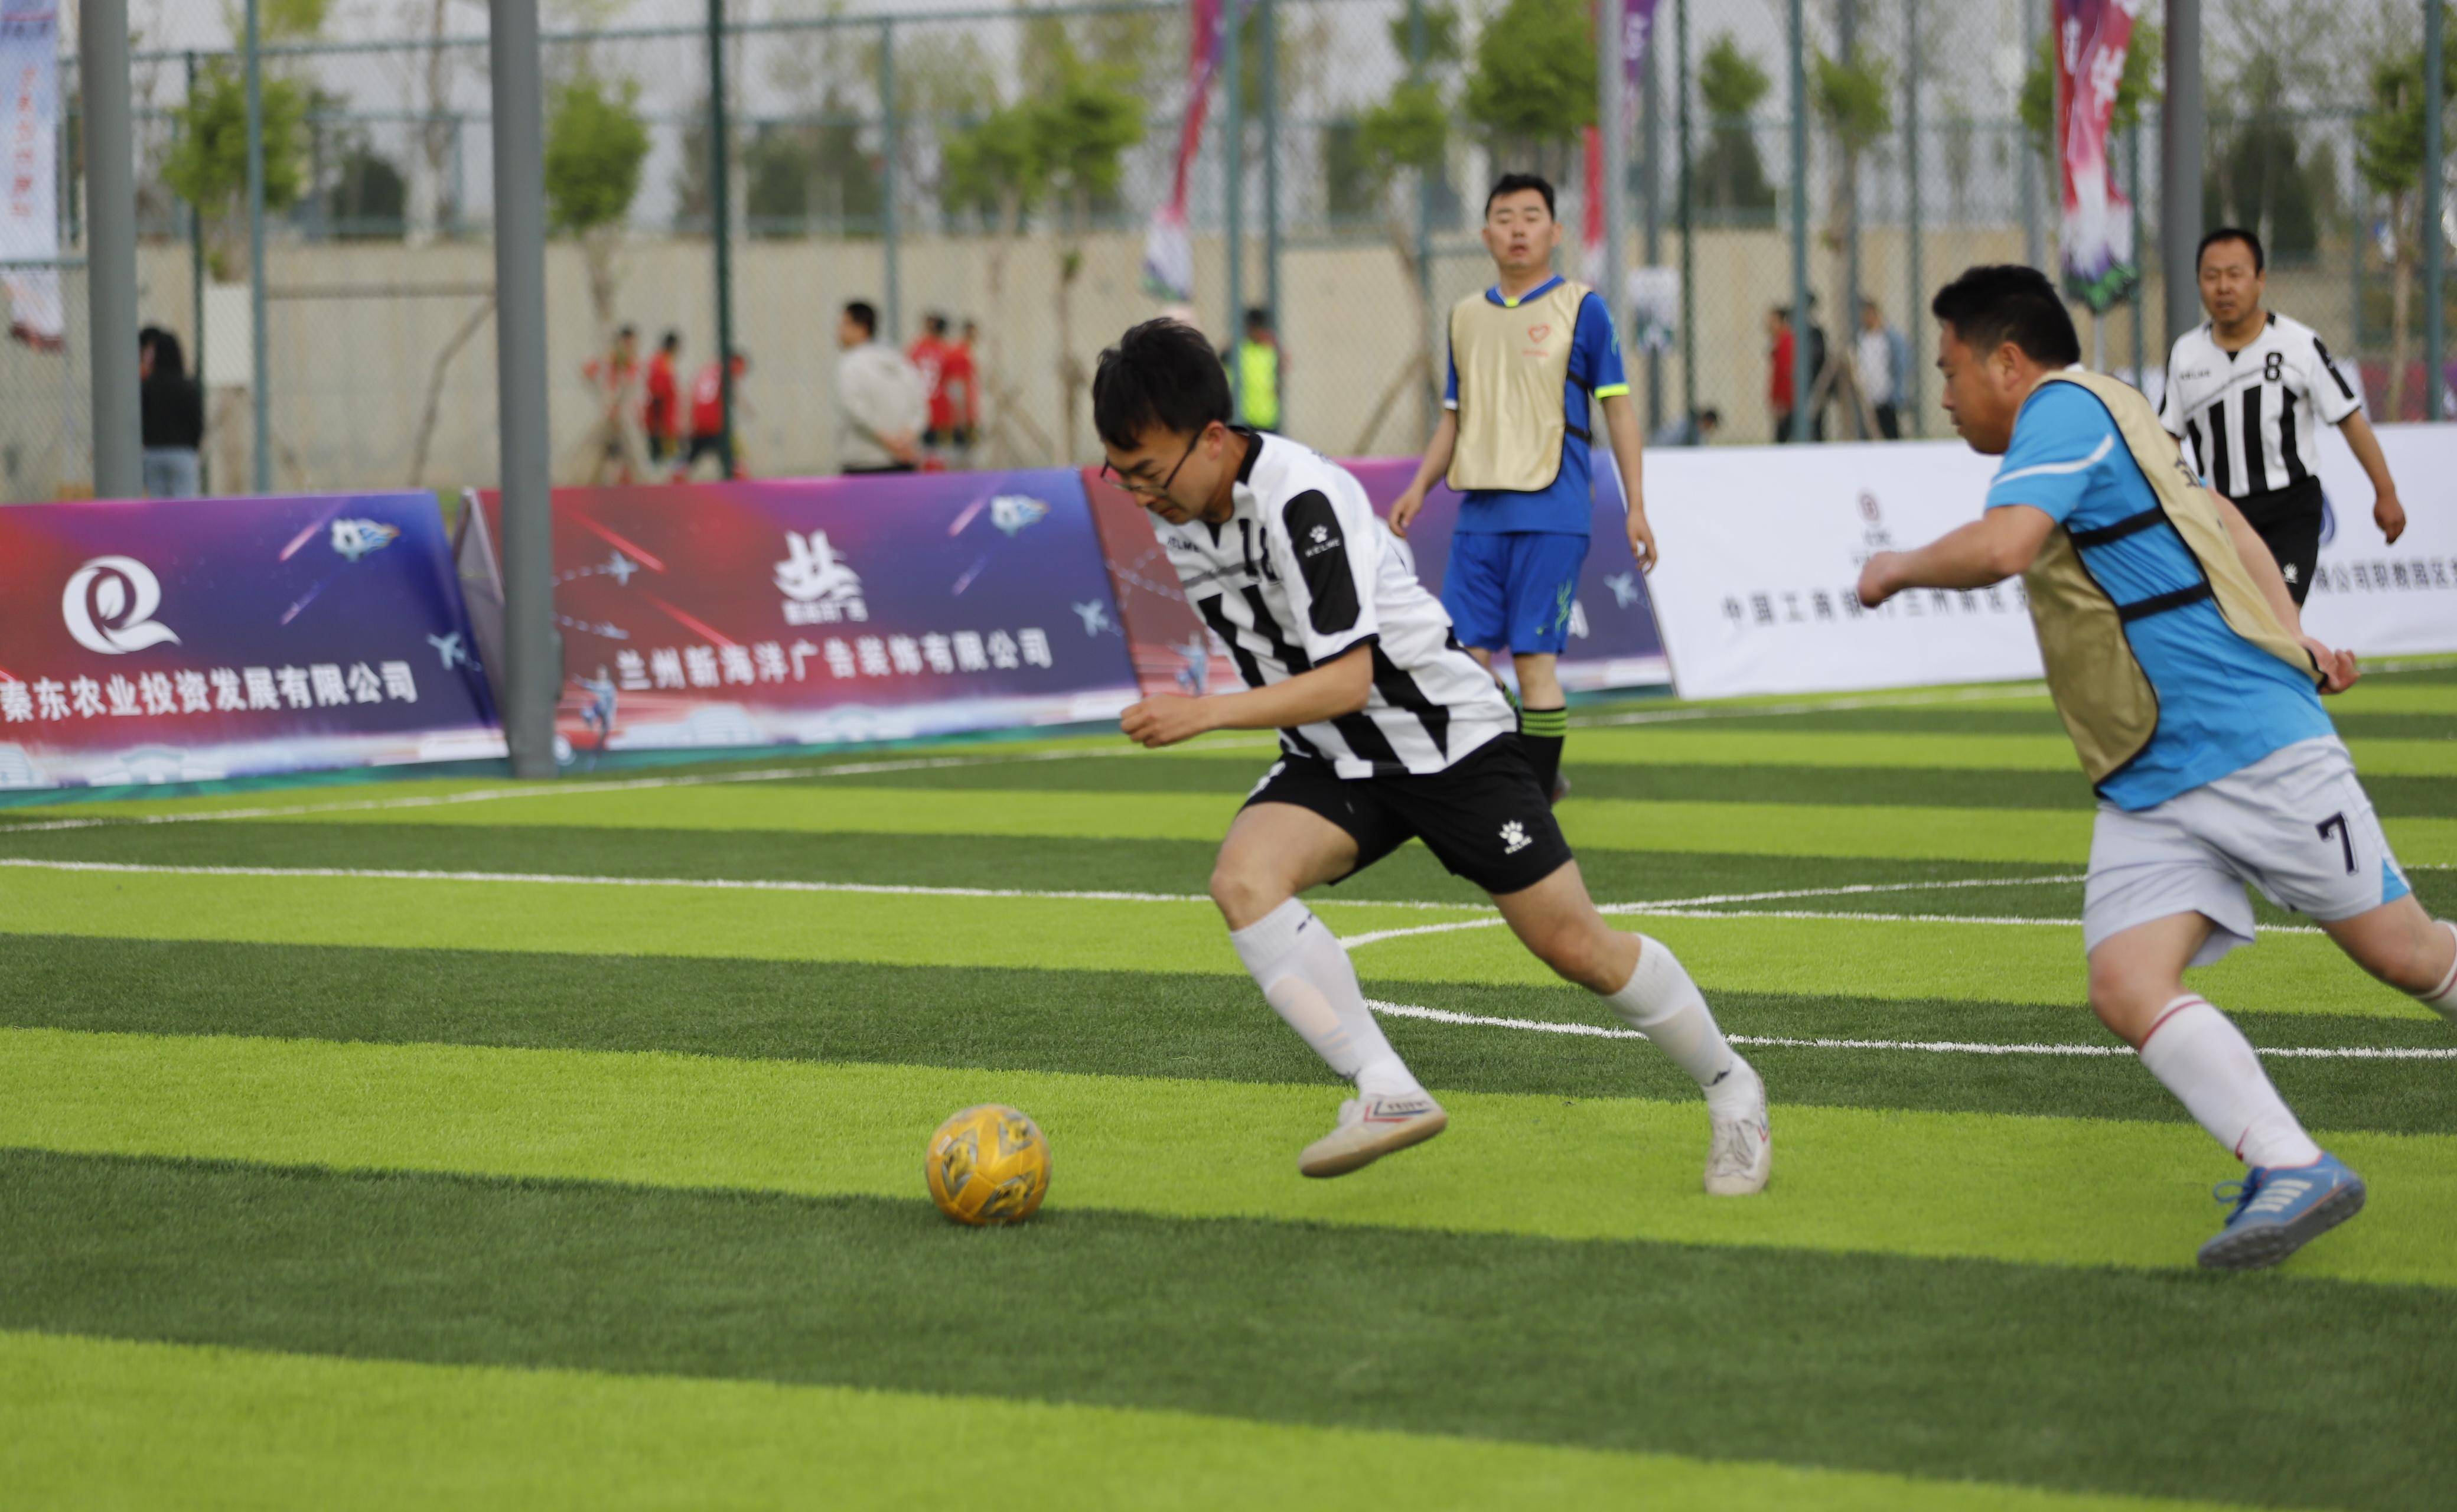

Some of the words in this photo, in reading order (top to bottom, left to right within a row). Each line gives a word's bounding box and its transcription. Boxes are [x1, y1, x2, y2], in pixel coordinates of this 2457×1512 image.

[2265, 352, 2284, 381] 8
[1305, 537, 1341, 558] KELME
[2315, 812, 2359, 876] 7
